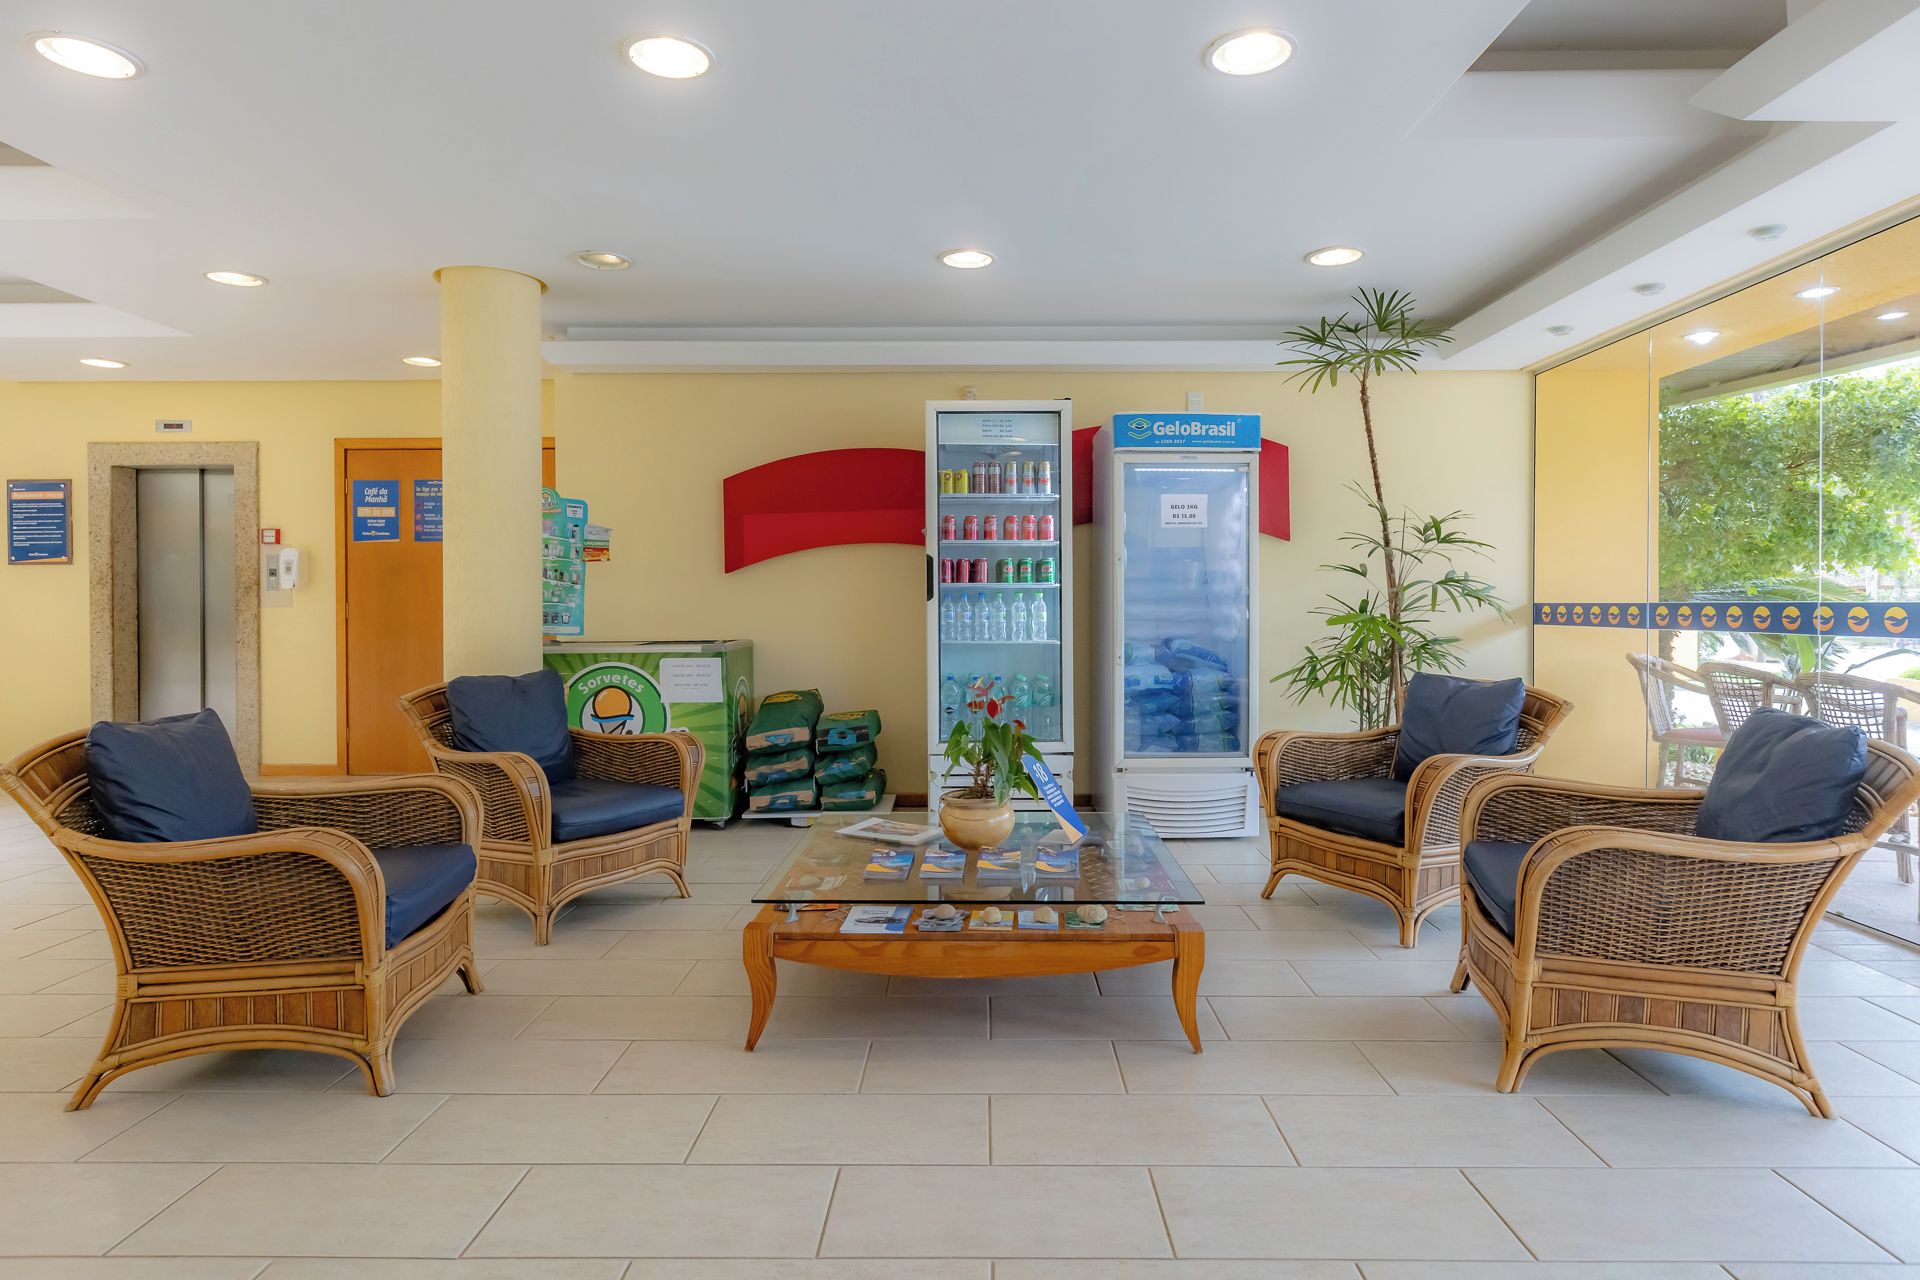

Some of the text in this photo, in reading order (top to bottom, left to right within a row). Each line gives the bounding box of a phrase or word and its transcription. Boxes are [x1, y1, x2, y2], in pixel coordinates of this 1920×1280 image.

[1153, 421, 1236, 436] GeloBrasil
[364, 487, 388, 496] Café da
[364, 495, 388, 503] Manhã
[578, 673, 644, 694] Sorvetes
